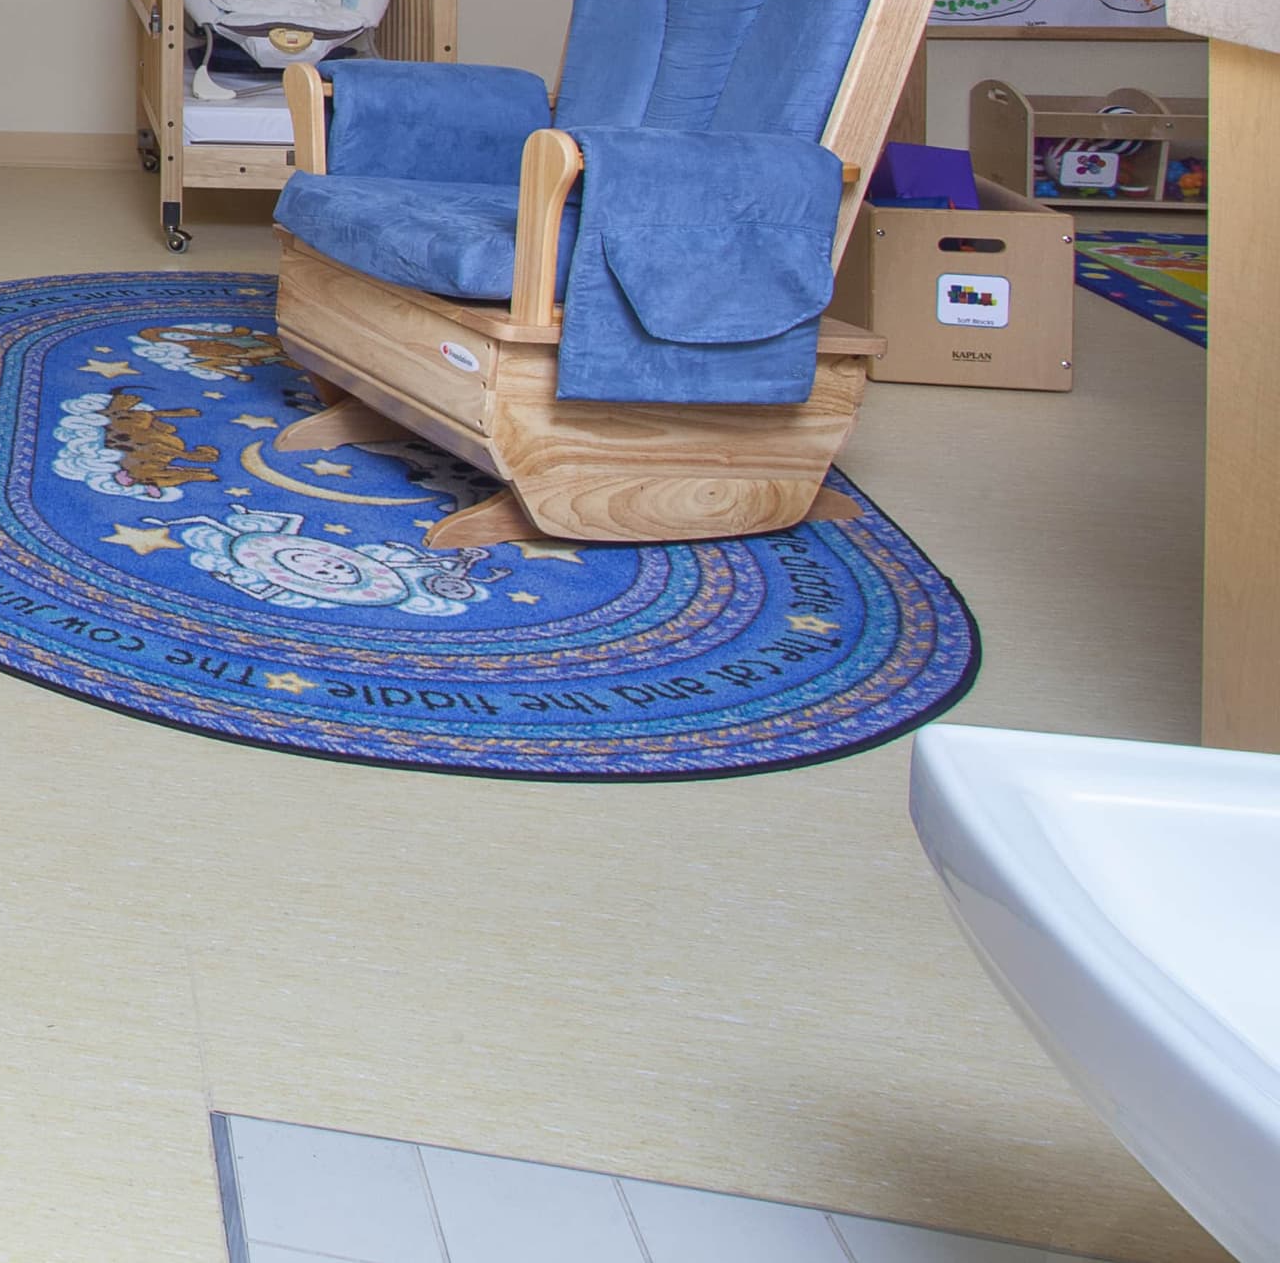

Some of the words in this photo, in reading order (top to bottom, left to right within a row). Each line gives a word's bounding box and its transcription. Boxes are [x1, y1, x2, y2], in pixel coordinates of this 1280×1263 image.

[73, 288, 136, 302] such
[145, 287, 233, 299] sport
[952, 350, 993, 360] KAPLAN
[778, 555, 845, 616] diddle
[51, 614, 147, 654] cow
[756, 629, 841, 665] The
[165, 647, 258, 689] The
[706, 659, 787, 689] cat
[325, 678, 501, 717] fiddle
[508, 687, 613, 716] the
[608, 676, 717, 710] and
